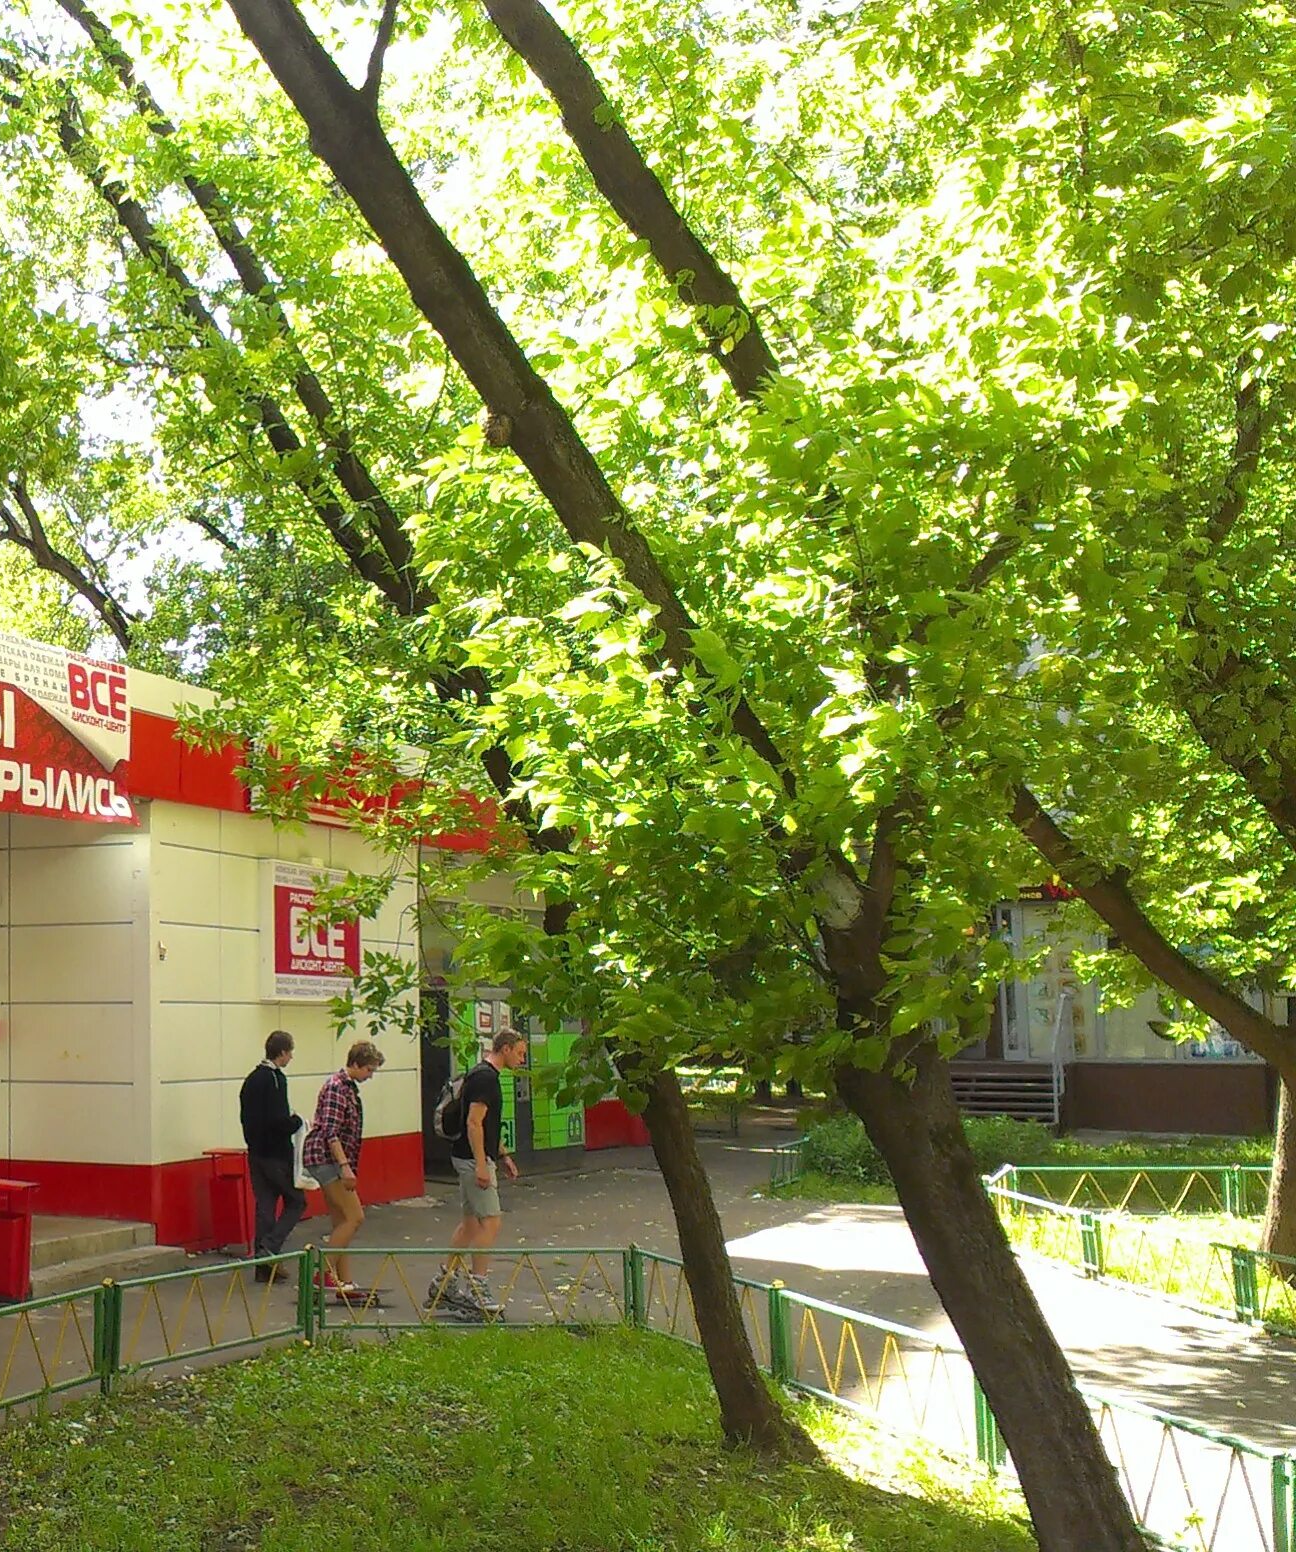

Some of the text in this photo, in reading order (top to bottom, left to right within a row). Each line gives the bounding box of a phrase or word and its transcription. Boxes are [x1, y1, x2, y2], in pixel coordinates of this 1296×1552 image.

[30, 651, 65, 667] ОДЕЖДА
[15, 671, 67, 692] БРЕНДЫ
[44, 667, 67, 680] ДОМА
[68, 663, 127, 721] ВСЕ
